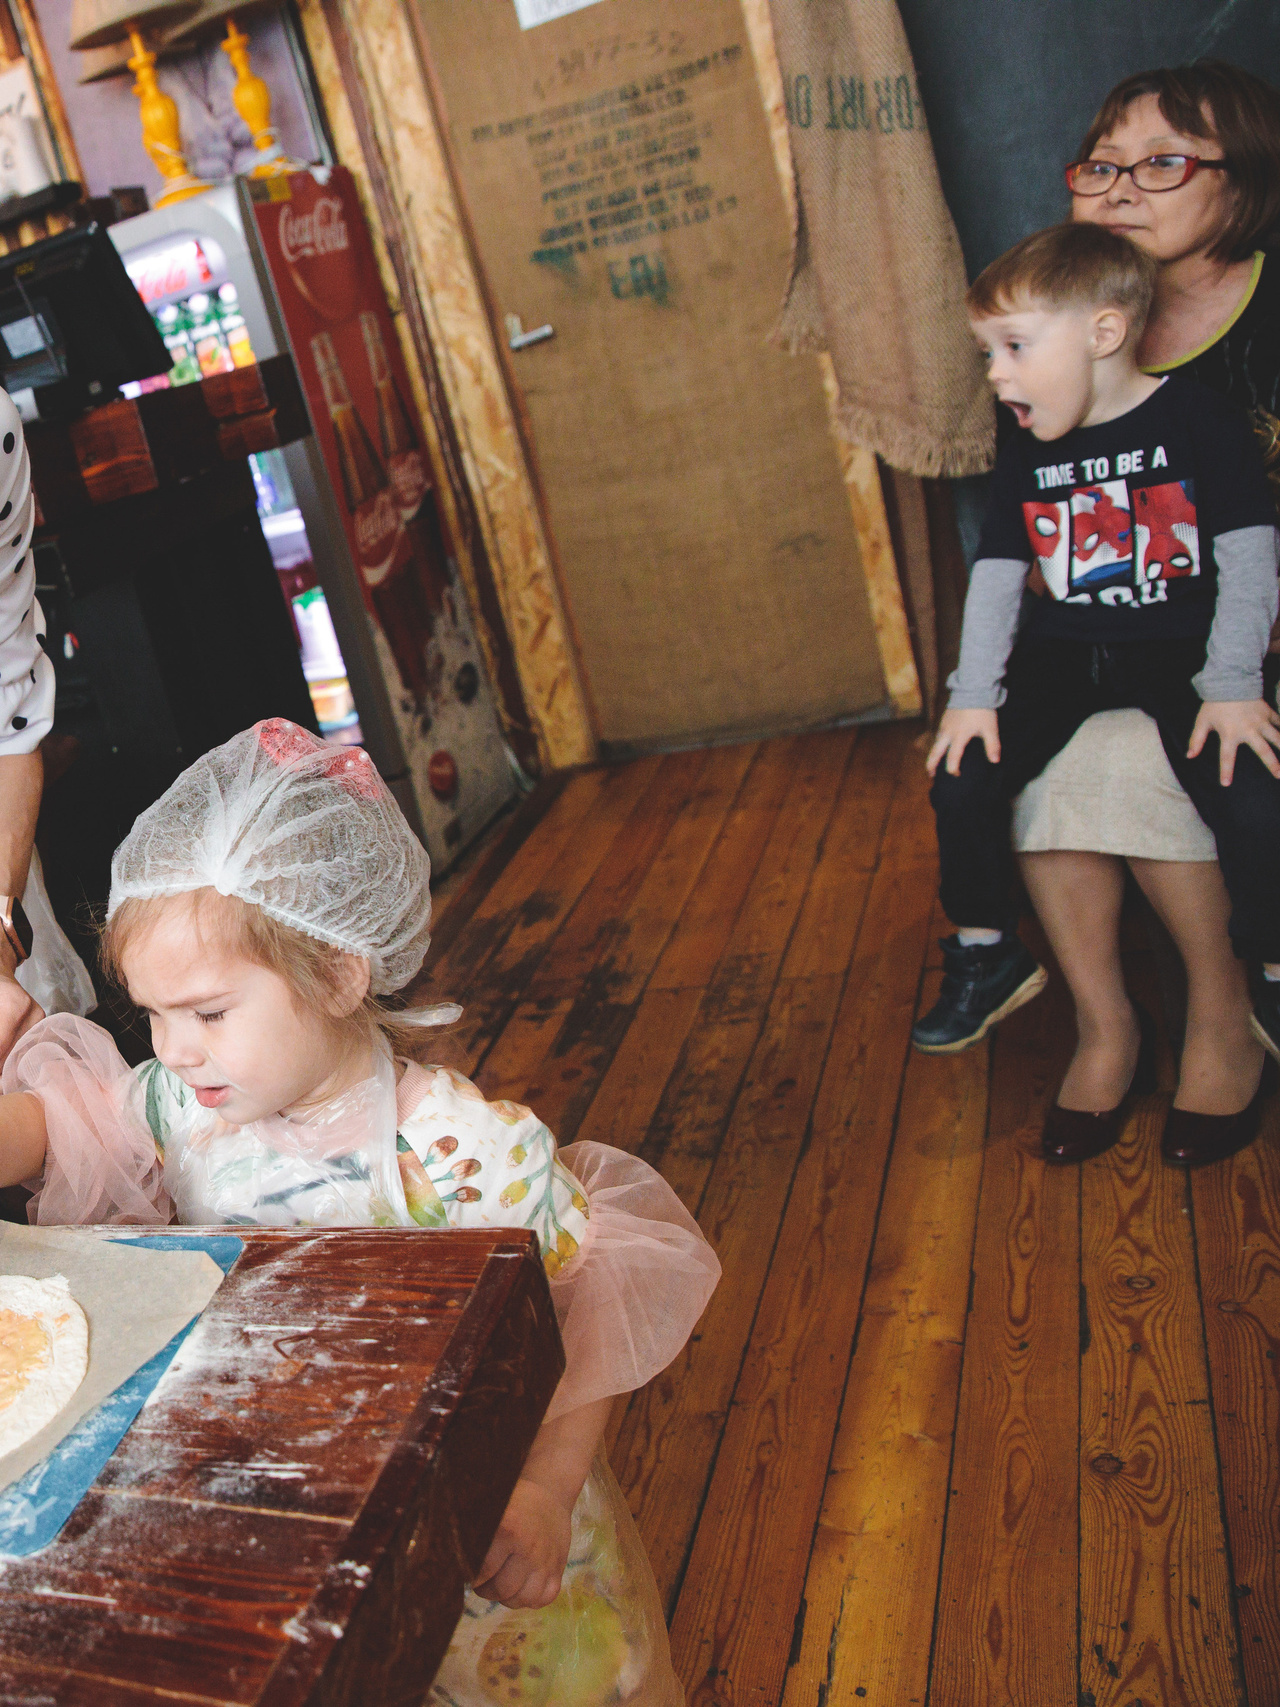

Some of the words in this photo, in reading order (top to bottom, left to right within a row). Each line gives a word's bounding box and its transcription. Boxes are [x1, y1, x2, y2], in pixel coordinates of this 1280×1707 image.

[1034, 463, 1076, 489] TIME
[1081, 457, 1109, 482] TO
[1116, 450, 1144, 475] BE
[1152, 446, 1168, 469] A
